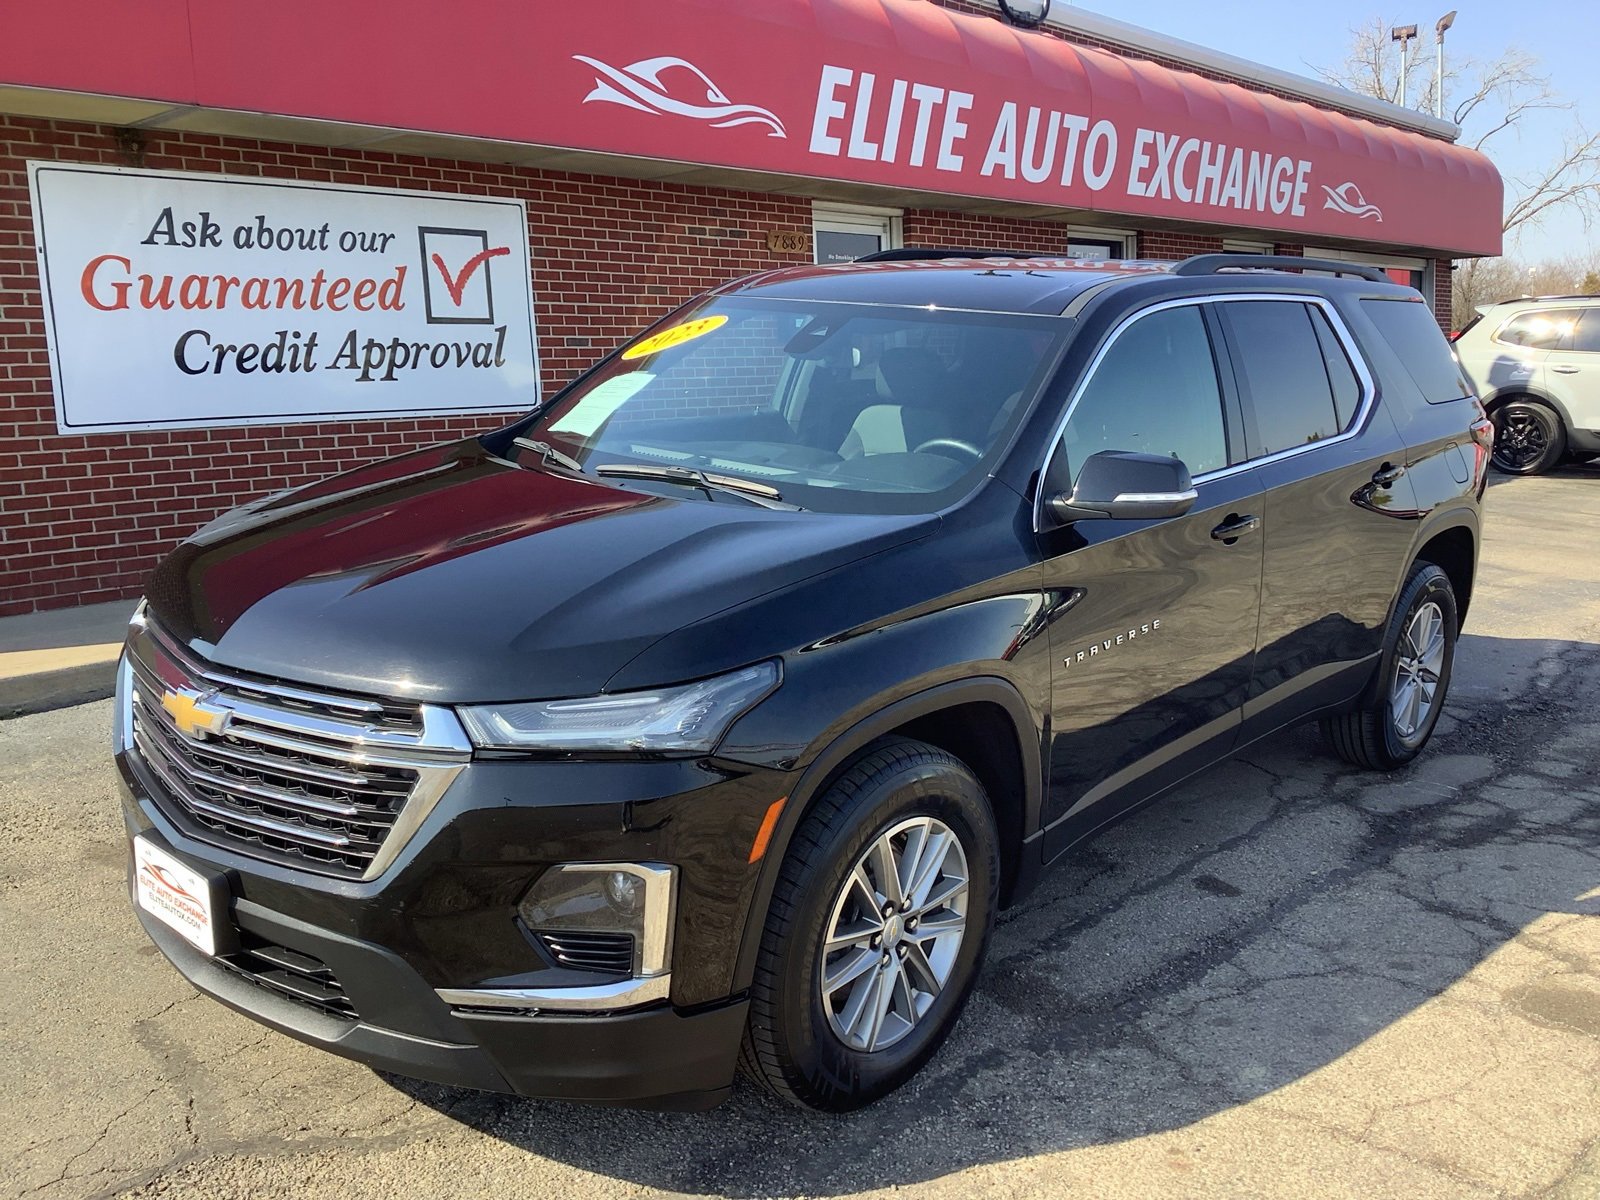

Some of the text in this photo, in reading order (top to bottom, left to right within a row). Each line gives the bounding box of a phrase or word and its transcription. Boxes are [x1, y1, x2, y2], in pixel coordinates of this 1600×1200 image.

[808, 64, 1312, 217] ELITE AUTO EXCHANGE
[141, 206, 396, 254] Ask about our
[773, 235, 805, 250] 7889
[80, 254, 407, 311] Guaranteed
[173, 324, 508, 383] Credit Approval
[1063, 619, 1160, 668] TRAVERSE
[140, 874, 156, 891] ELITE
[156, 886, 173, 903] AUTO
